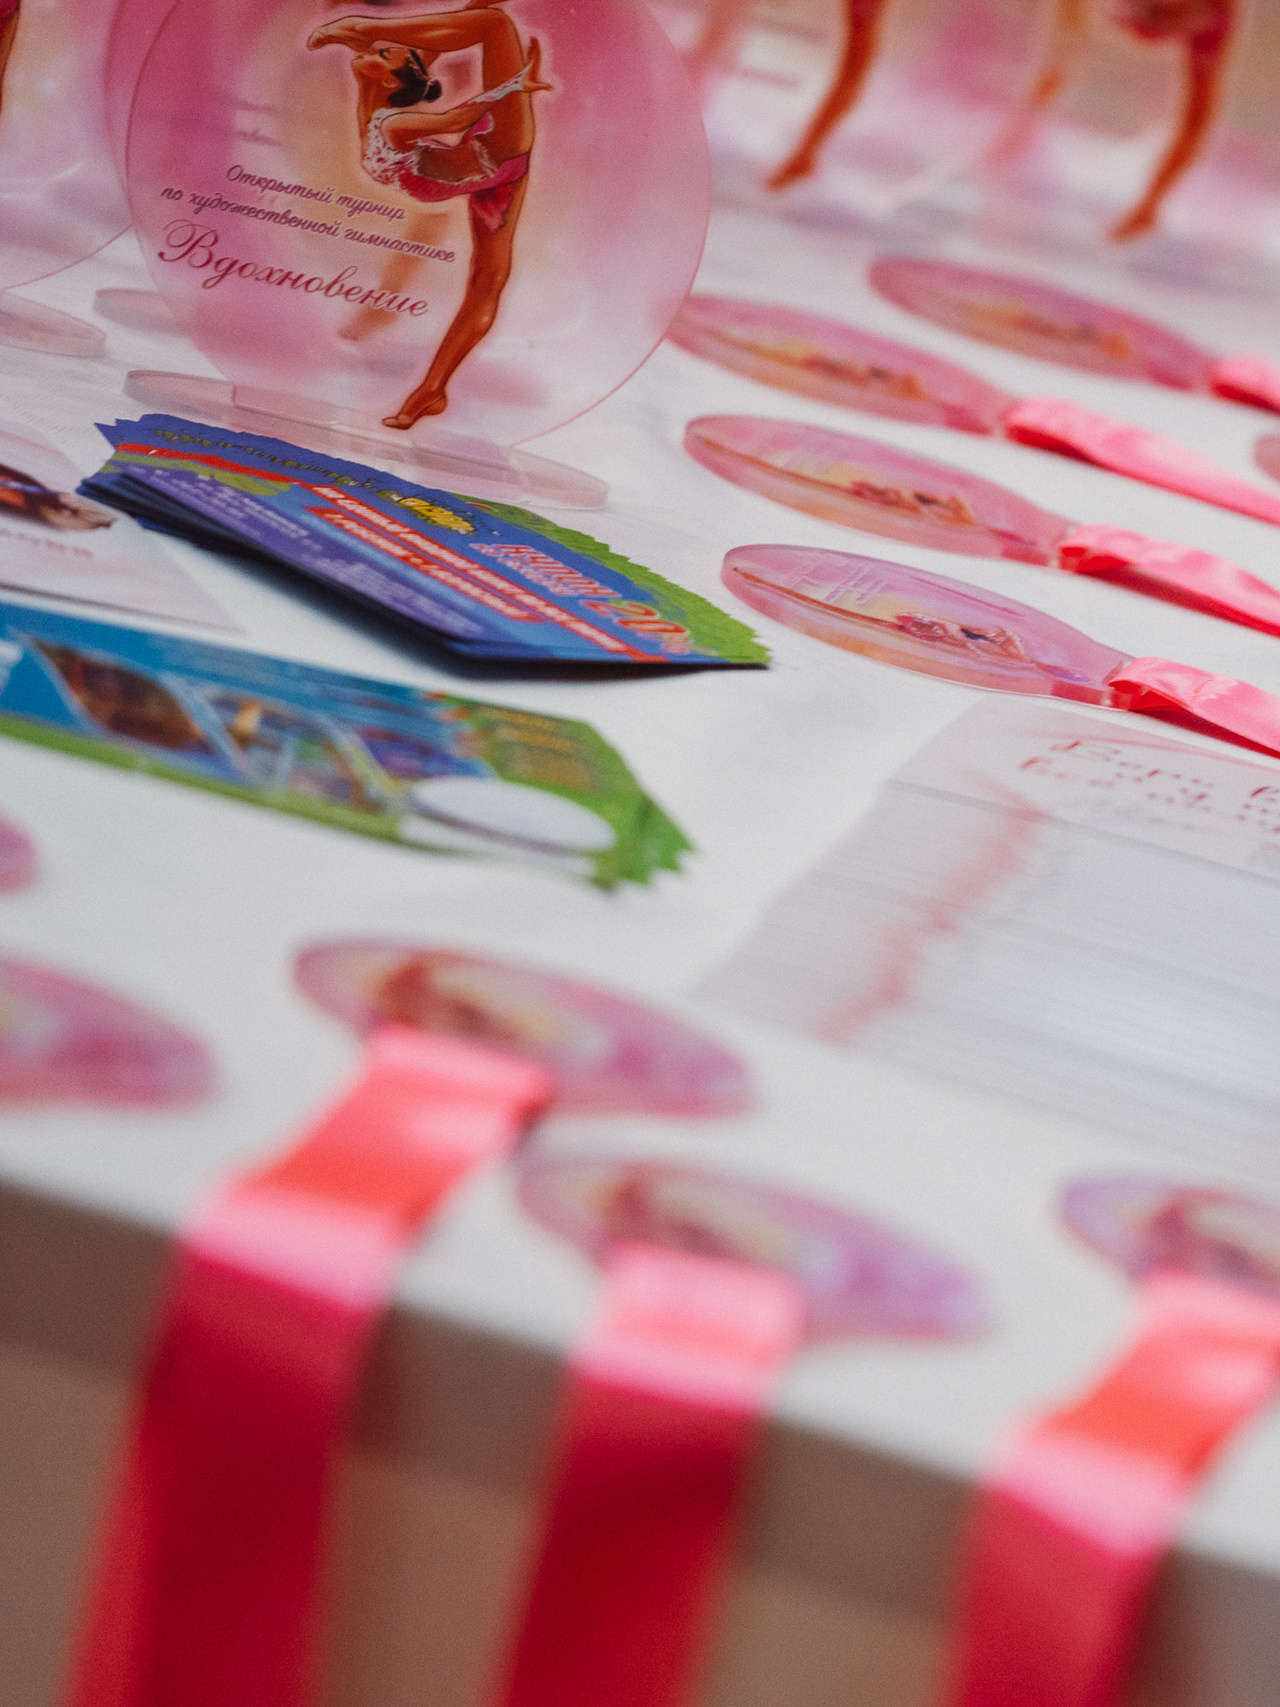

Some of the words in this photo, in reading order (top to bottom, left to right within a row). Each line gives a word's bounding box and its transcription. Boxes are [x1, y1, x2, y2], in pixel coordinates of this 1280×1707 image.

[160, 186, 184, 202] по
[188, 191, 339, 239] художественной
[344, 227, 456, 263] гимнастике
[226, 164, 332, 205] Открытый
[335, 192, 406, 222] турнир
[157, 218, 429, 317] Вдохновение
